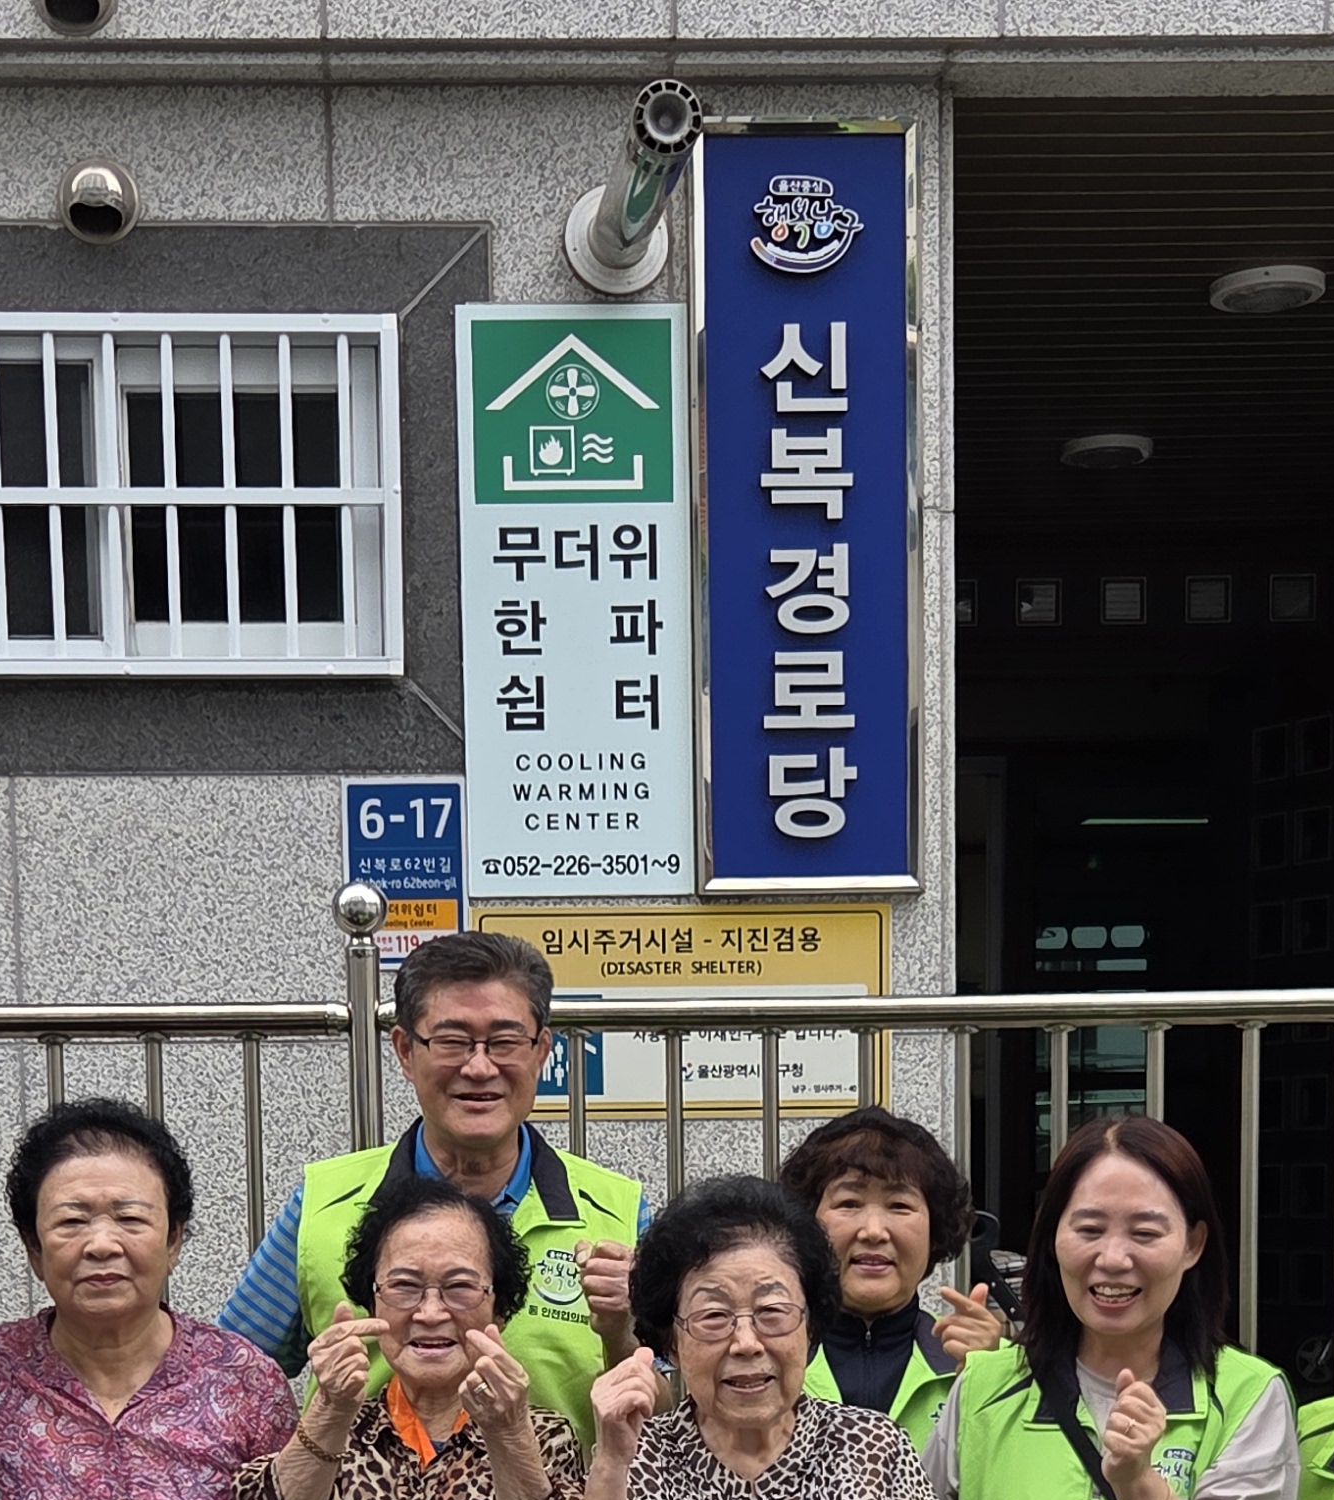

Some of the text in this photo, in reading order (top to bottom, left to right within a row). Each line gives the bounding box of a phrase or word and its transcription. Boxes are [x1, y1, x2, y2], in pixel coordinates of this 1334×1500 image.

[752, 196, 864, 252] 행복남구
[493, 523, 659, 583] 무더위
[760, 320, 857, 839] 신복경로당
[515, 752, 647, 772] COOLING
[513, 782, 650, 802] WARMING
[359, 797, 453, 840] 6-17
[525, 812, 641, 832] CENTER
[502, 855, 681, 877] 052-226-3501~9
[542, 929, 694, 955] 임시주거시설
[720, 926, 823, 953] 지진겸용
[600, 960, 763, 978] (DISASTER SHELTER)
[697, 1063, 804, 1079] 울산광역시 구청
